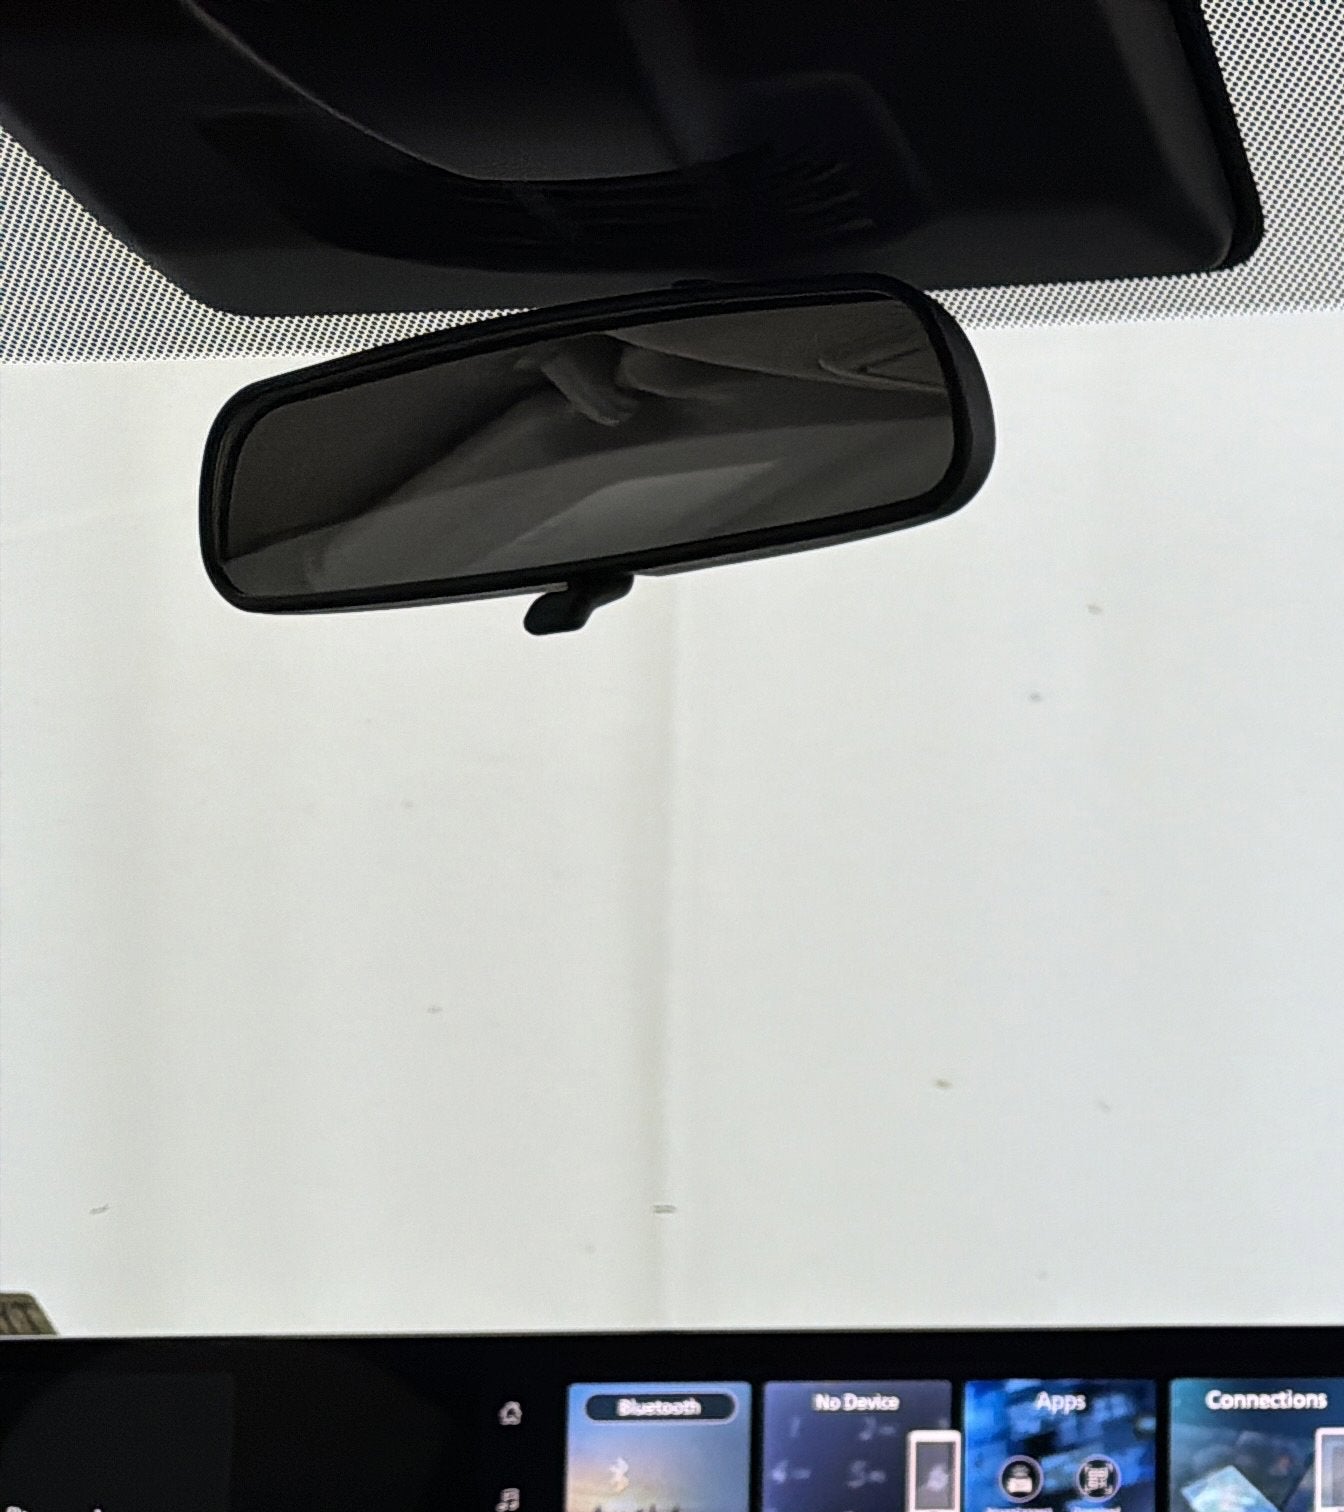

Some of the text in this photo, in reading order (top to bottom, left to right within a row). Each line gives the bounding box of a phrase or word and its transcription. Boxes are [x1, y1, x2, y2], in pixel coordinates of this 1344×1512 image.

[616, 1398, 702, 1418] Bluetooth
[813, 1392, 900, 1412] No Device
[1036, 1391, 1087, 1415] Apps
[1204, 1388, 1328, 1411] Connections
